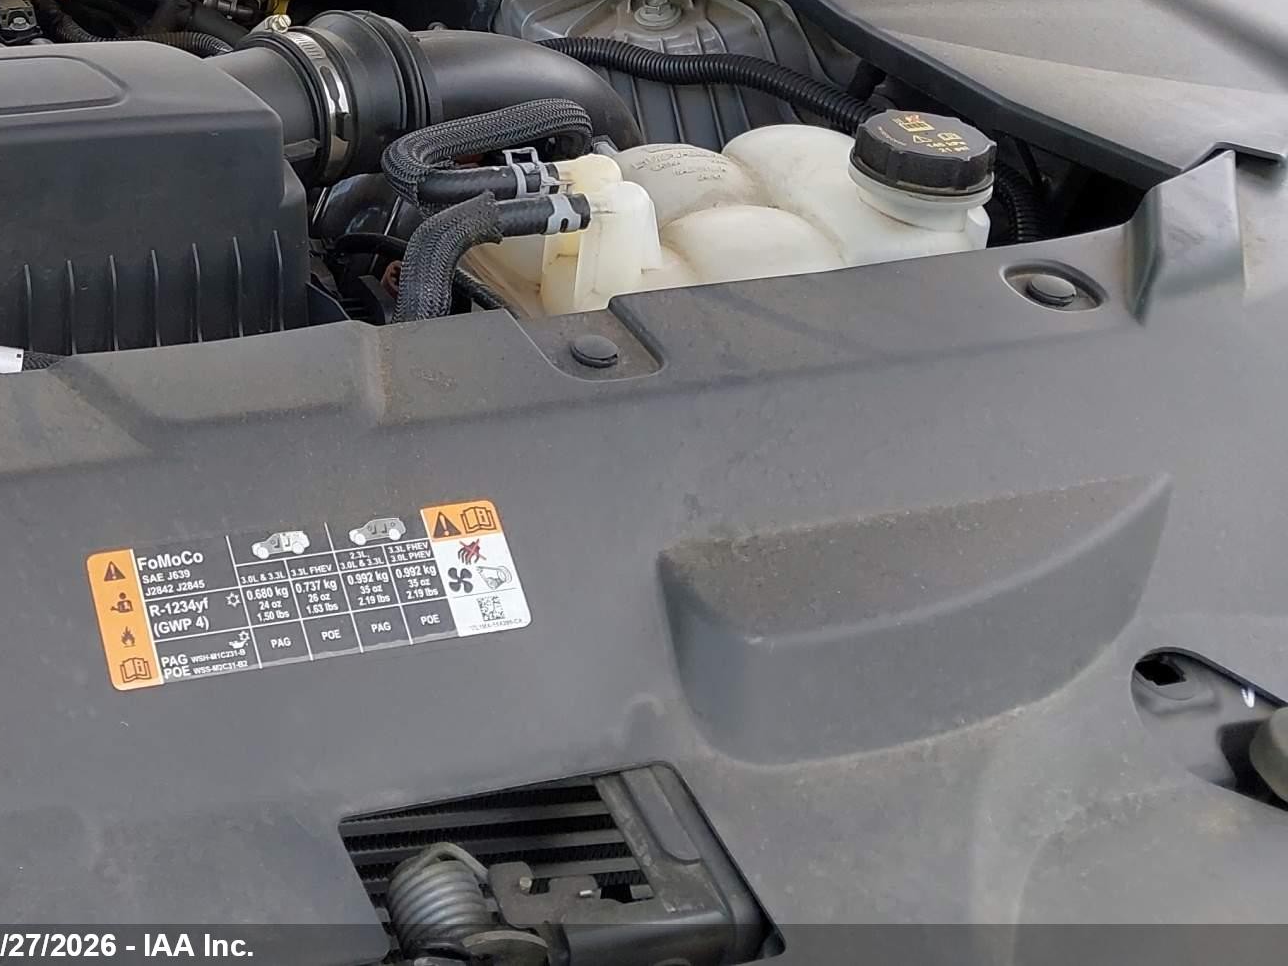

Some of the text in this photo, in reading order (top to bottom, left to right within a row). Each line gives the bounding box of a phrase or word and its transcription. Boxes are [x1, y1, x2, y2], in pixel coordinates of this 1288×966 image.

[388, 540, 429, 554] 3.3L FHEV
[137, 551, 204, 571] FoMoCo
[339, 556, 385, 571] 3.0L & 3.3L
[391, 550, 432, 563] 3.0L PHEV
[142, 569, 191, 585] SAE J639
[240, 570, 286, 585] 3.0L & 3.3L
[290, 563, 333, 578] 3.3L FHEV
[396, 564, 438, 579] 0.992 kg
[346, 570, 389, 586] 0.992 kg
[408, 578, 431, 589] 35 oz
[145, 579, 206, 597] J2842 J2845
[245, 585, 289, 601] 0.680 kg
[295, 579, 338, 594] 0.737 kg
[359, 584, 383, 595] 35 oz
[307, 592, 332, 603] 26 oz
[358, 594, 391, 606] 2.19 lbs
[406, 588, 439, 600] 2.19 lbs
[149, 597, 209, 618] R-1234yf
[258, 599, 283, 611] 24 oz
[306, 602, 339, 615] 1.63 lbs
[275, 609, 290, 620] lbs
[420, 614, 441, 626] POE
[153, 615, 210, 637] (GWP 4)
[370, 622, 392, 634] PAG
[321, 629, 342, 641] POE
[270, 637, 292, 649] PAG
[161, 653, 189, 668] PAG
[163, 665, 192, 680] POE
